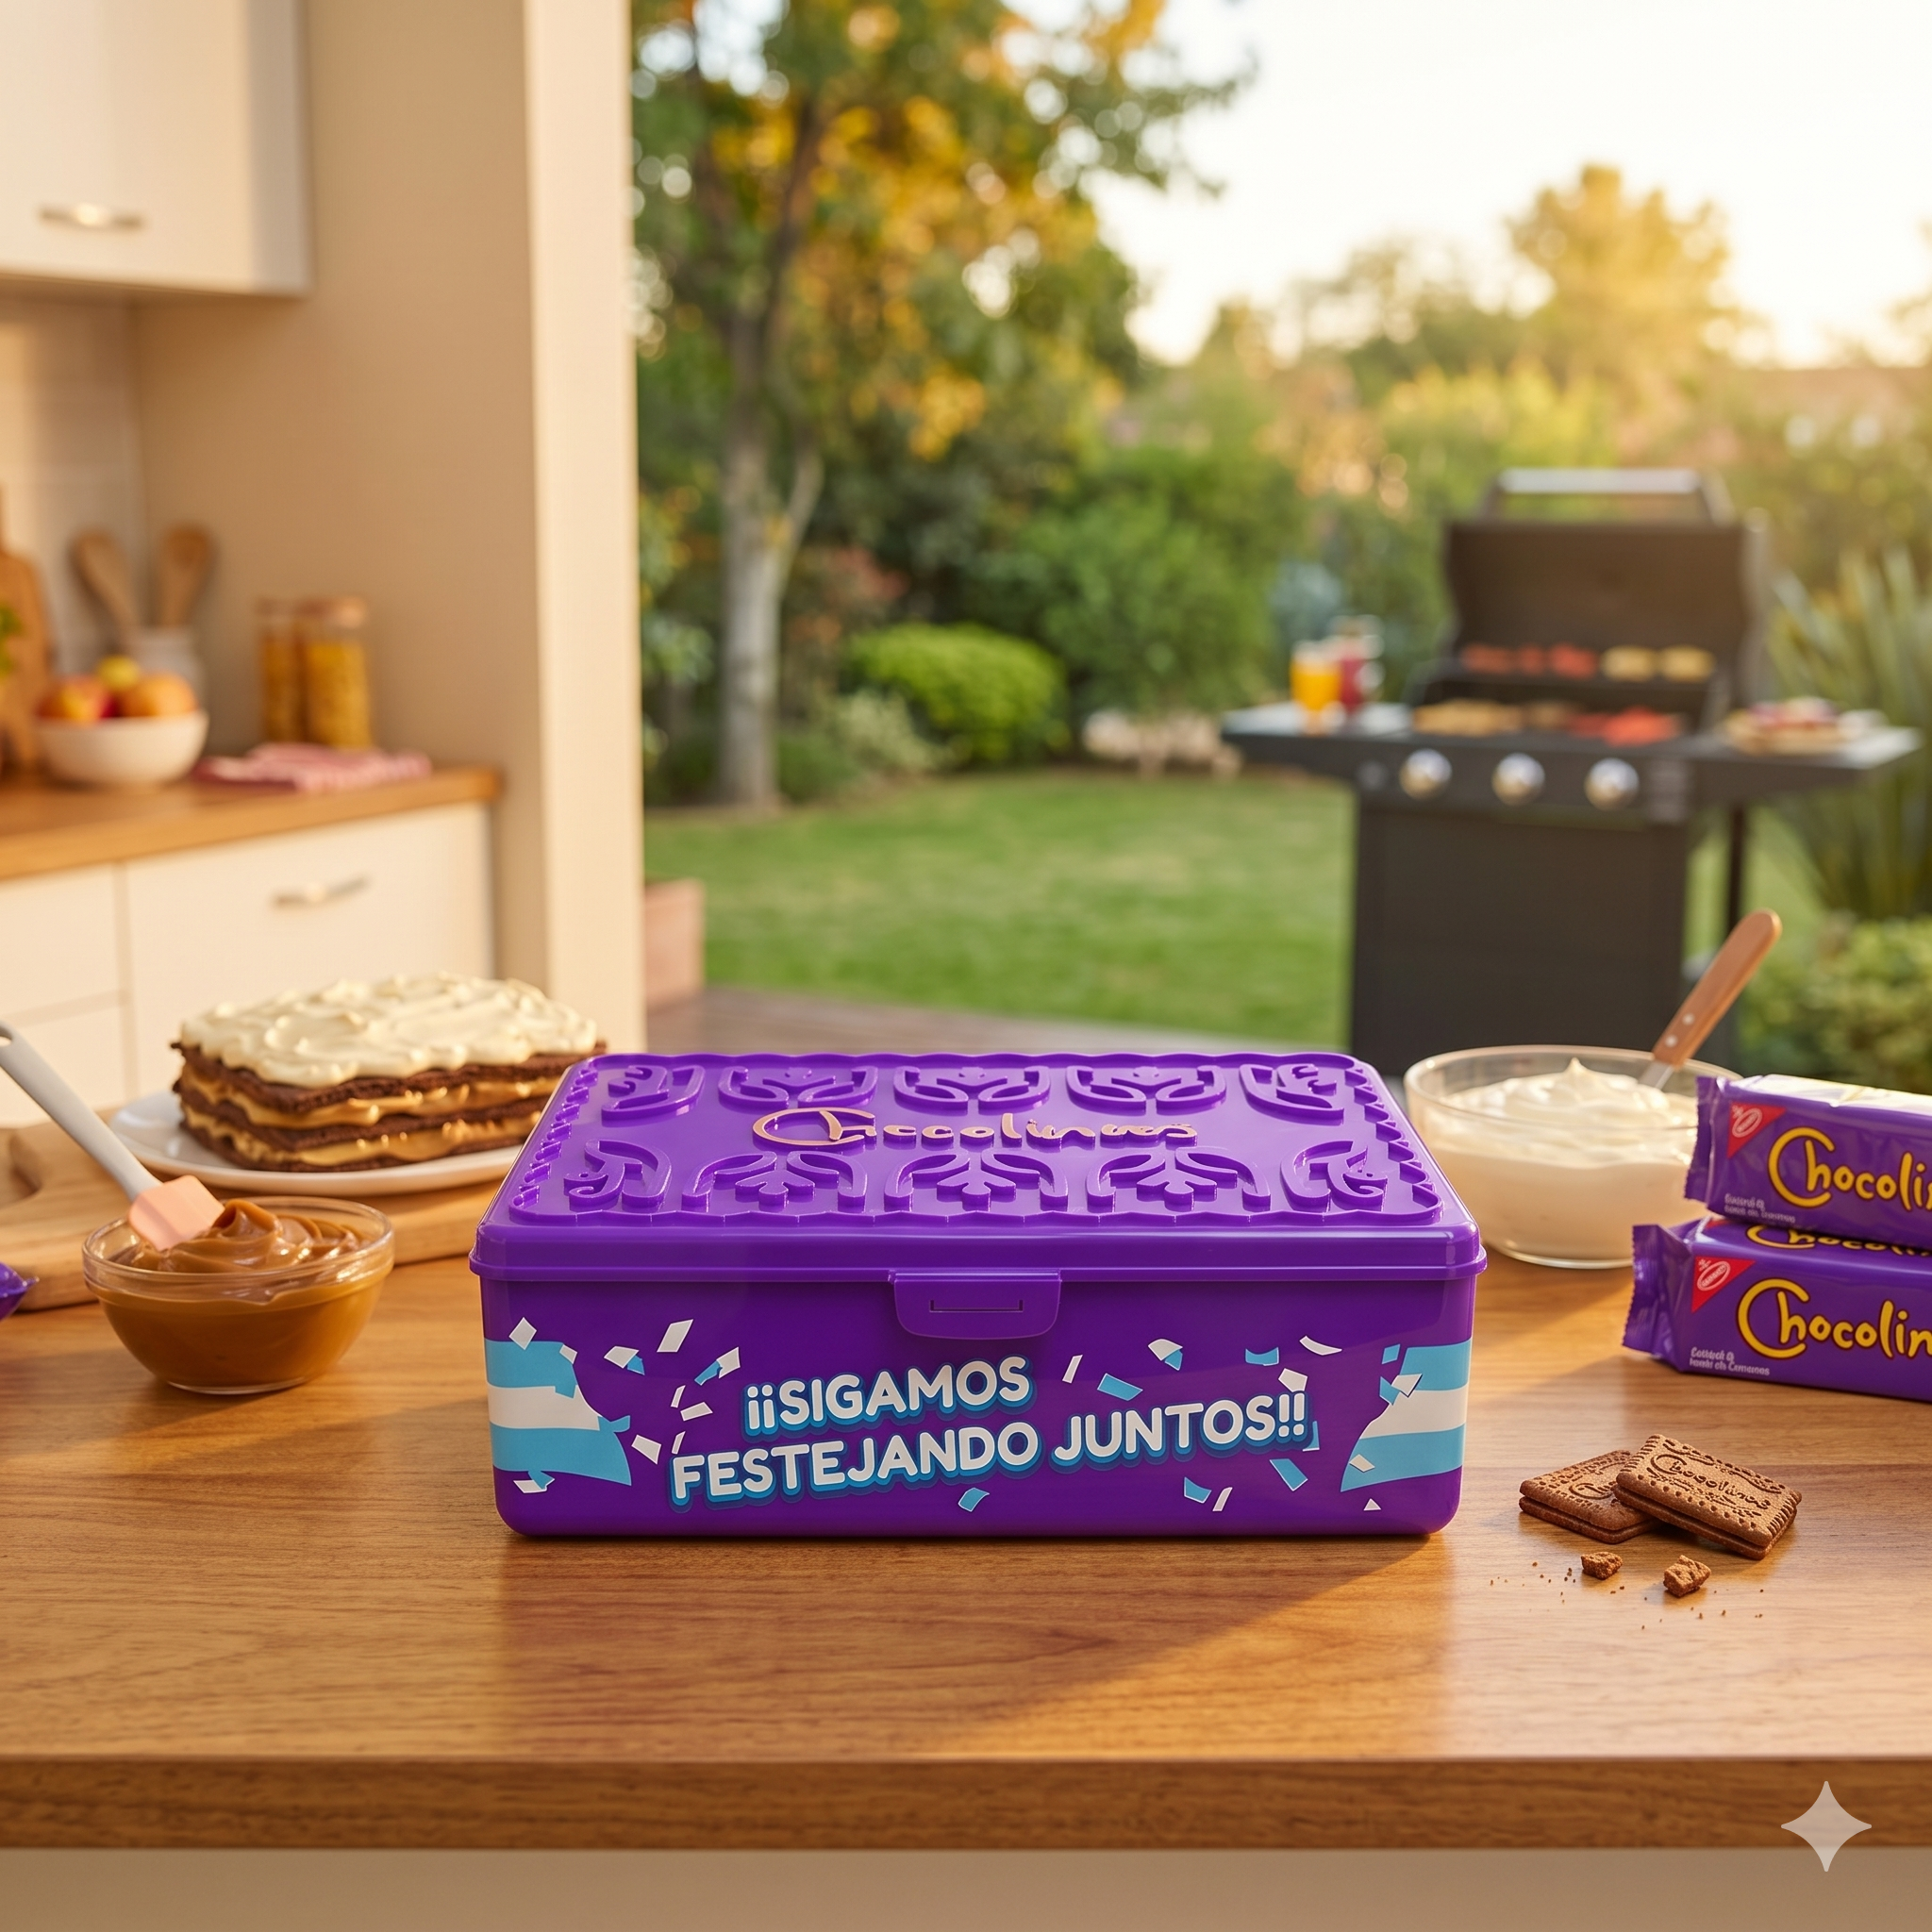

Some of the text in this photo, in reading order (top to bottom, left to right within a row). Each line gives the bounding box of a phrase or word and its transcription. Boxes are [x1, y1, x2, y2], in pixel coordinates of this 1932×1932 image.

[1768, 1126, 1932, 1211] Chocoli
[1737, 1277, 1932, 1358] Chocolin
[746, 1356, 1030, 1431] ¡¡SIGAMOS
[672, 1391, 1306, 1500] FESTEJANDO JUNTOS!!
